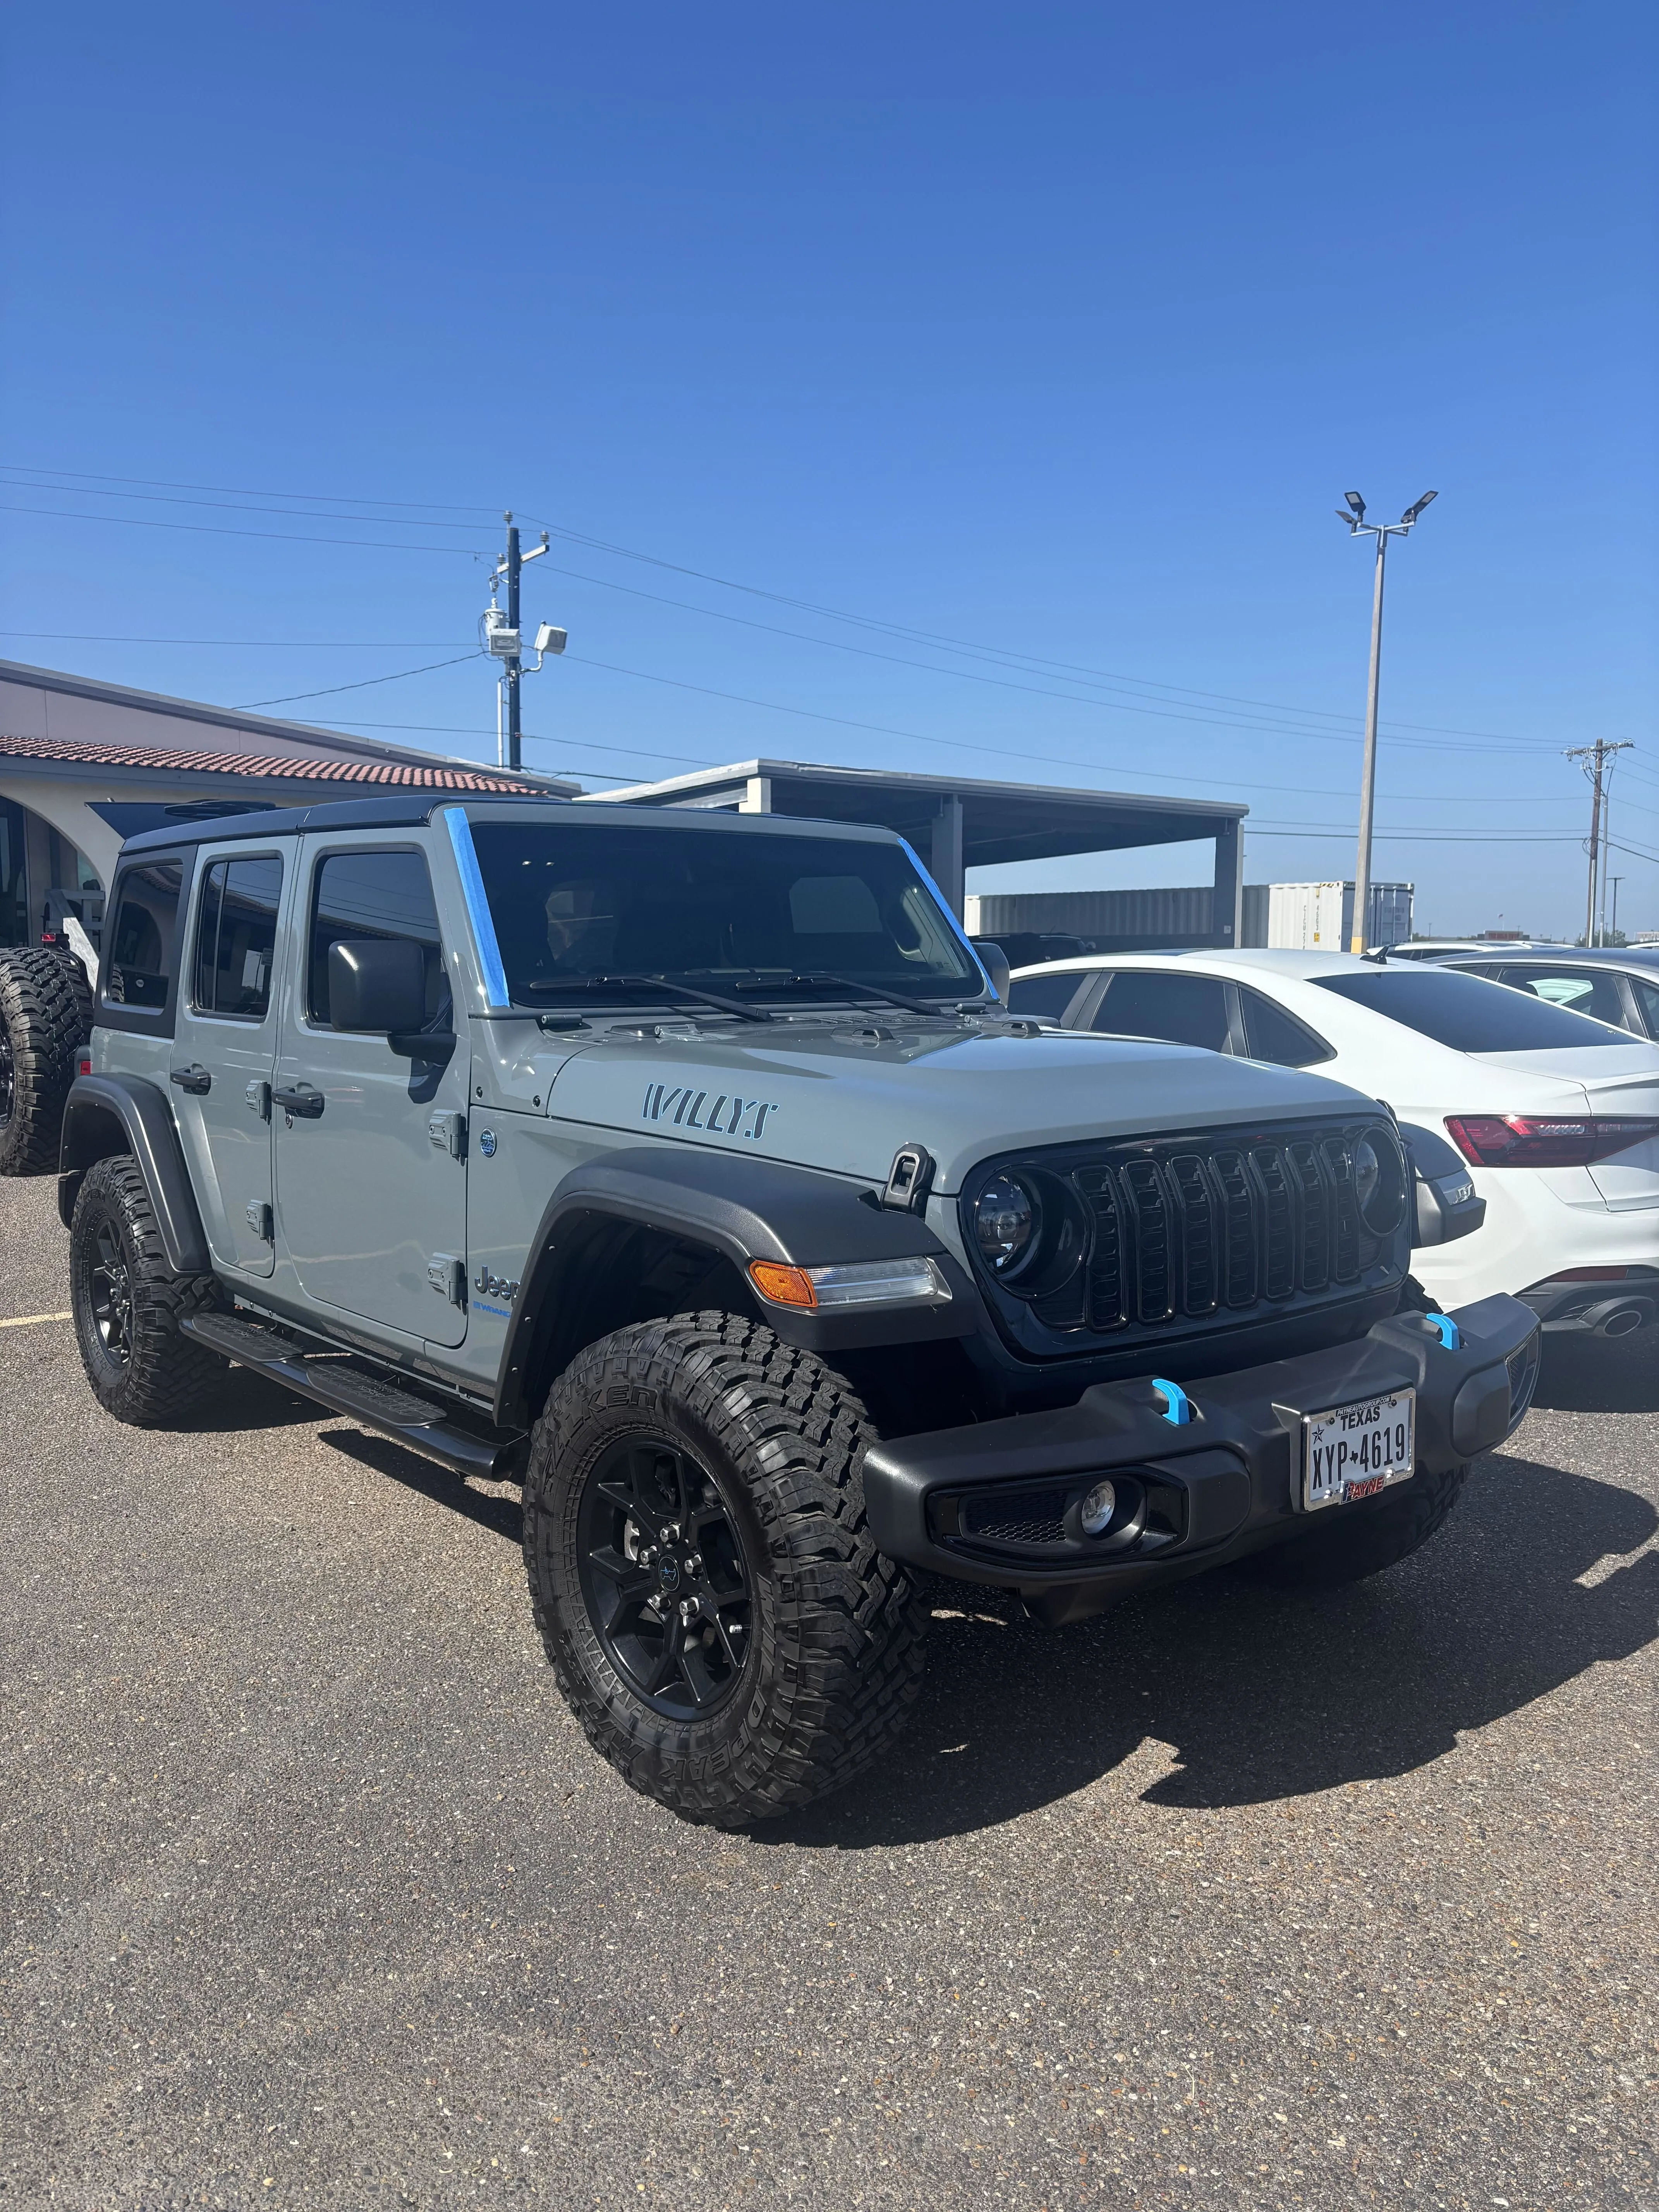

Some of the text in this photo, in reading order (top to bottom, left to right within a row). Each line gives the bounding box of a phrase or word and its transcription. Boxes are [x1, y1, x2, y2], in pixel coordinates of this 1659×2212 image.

[642, 1083, 780, 1140] WILLYS
[1337, 1396, 1390, 1416] PAYNEAUTOGROUP.COM
[1340, 1406, 1380, 1431] TEXAS
[1313, 1423, 1405, 1490] XYP 4619
[1341, 1475, 1384, 1503] PAYNE
